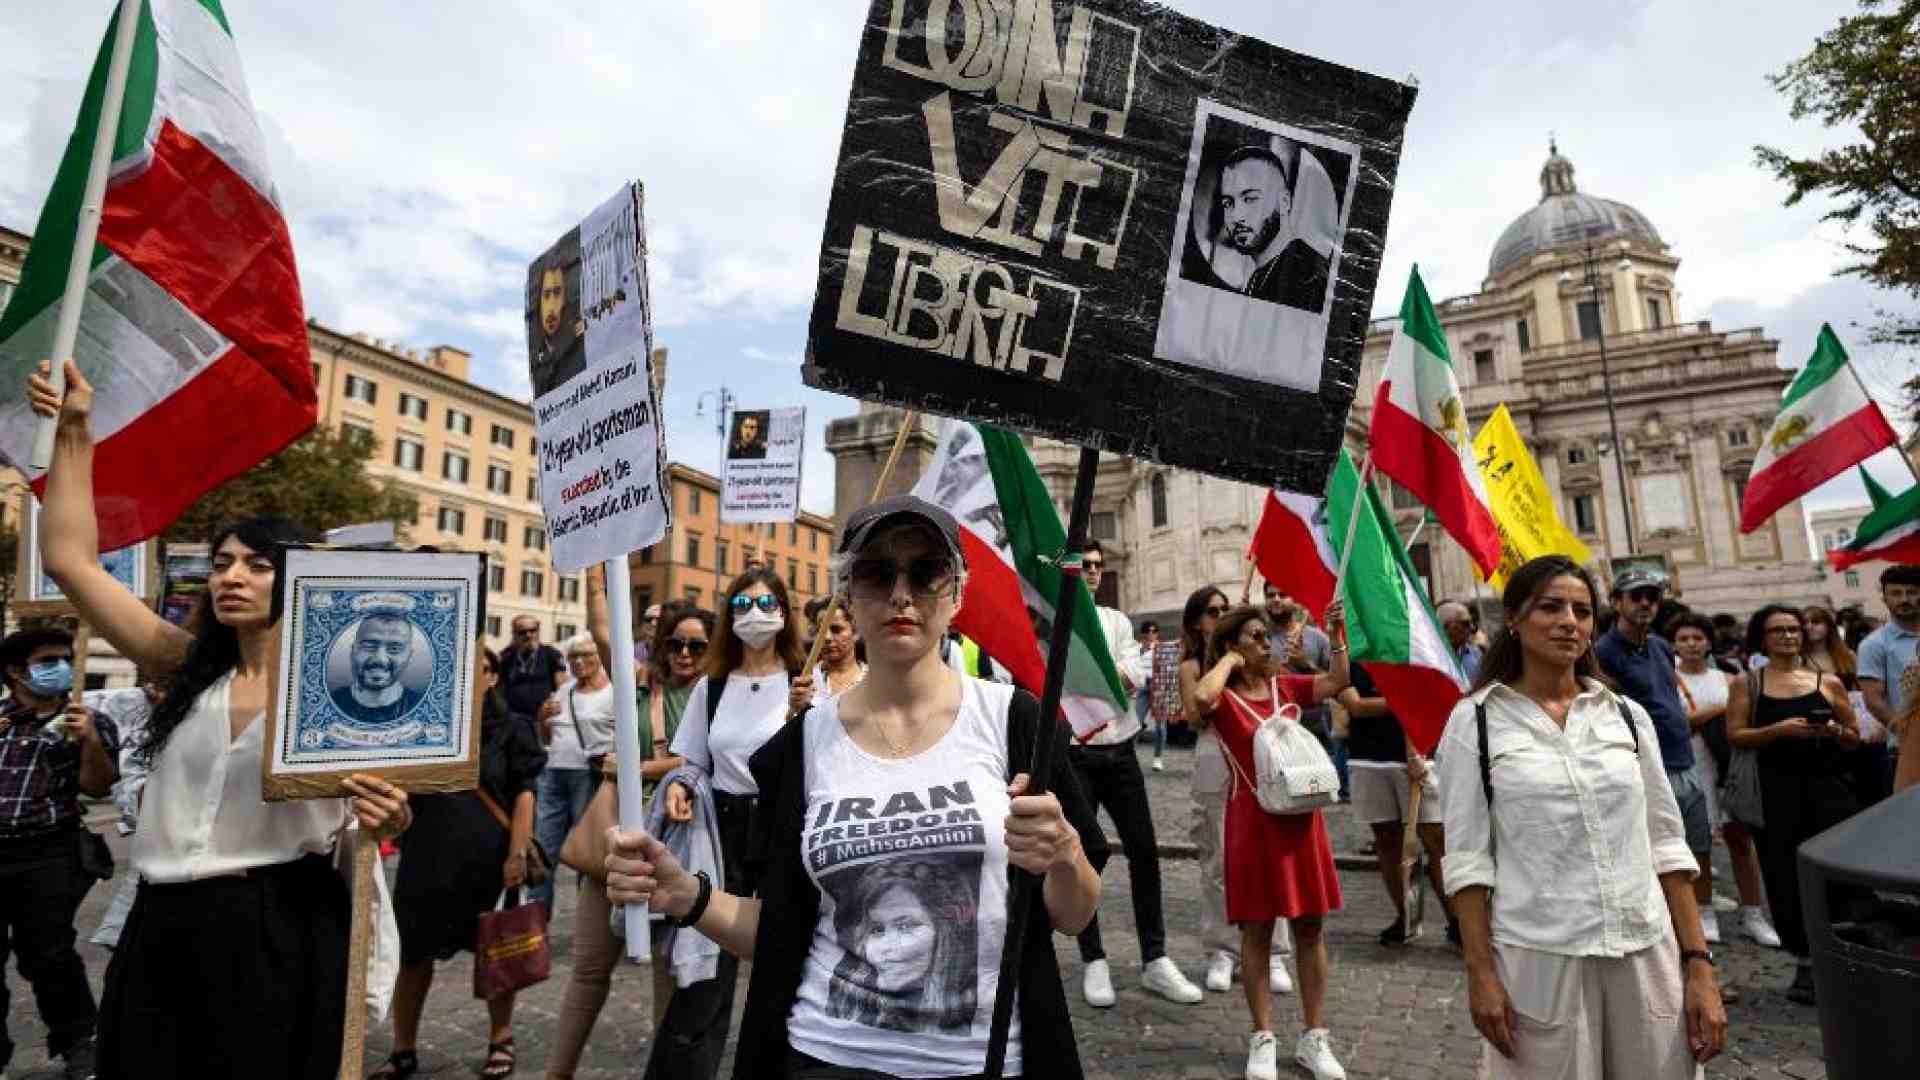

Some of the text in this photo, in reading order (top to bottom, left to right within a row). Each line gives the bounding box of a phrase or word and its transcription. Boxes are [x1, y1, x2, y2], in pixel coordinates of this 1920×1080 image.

[593, 400, 649, 453] sportsman
[813, 779, 977, 829] IRAN
[808, 806, 983, 851] FREEDOM
[836, 825, 974, 861] MahsaAmini
